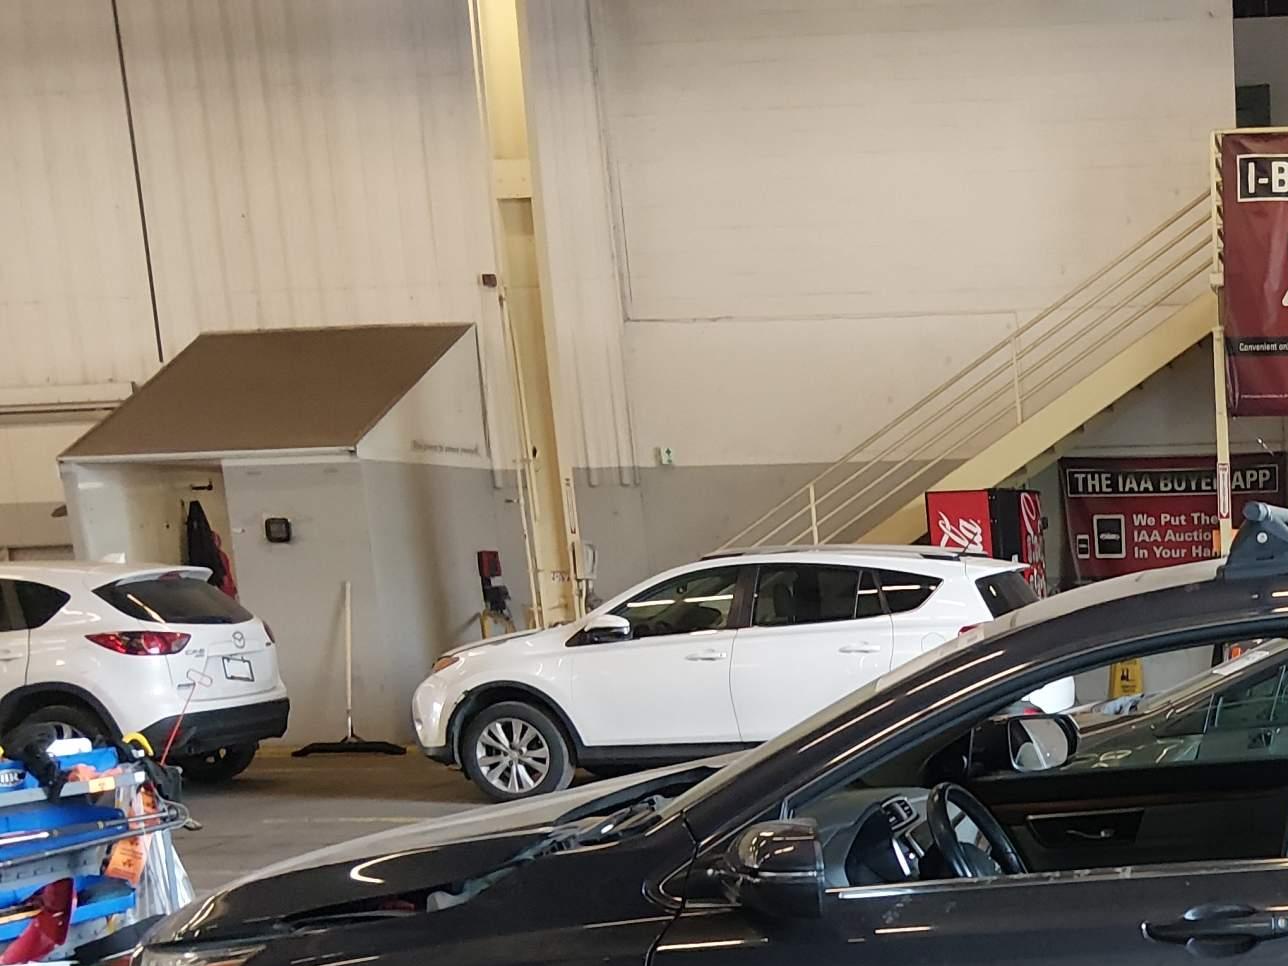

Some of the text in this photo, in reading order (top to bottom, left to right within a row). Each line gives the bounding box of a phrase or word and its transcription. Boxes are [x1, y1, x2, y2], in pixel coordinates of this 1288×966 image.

[1239, 342, 1278, 351] Convenient
[1074, 473, 1112, 492] THE
[1118, 472, 1154, 492] IAA
[1232, 469, 1271, 489] APP
[1133, 512, 1219, 526] We Put The
[1133, 529, 1212, 542] IAA Auctio
[1134, 545, 1221, 558] In Your Han
